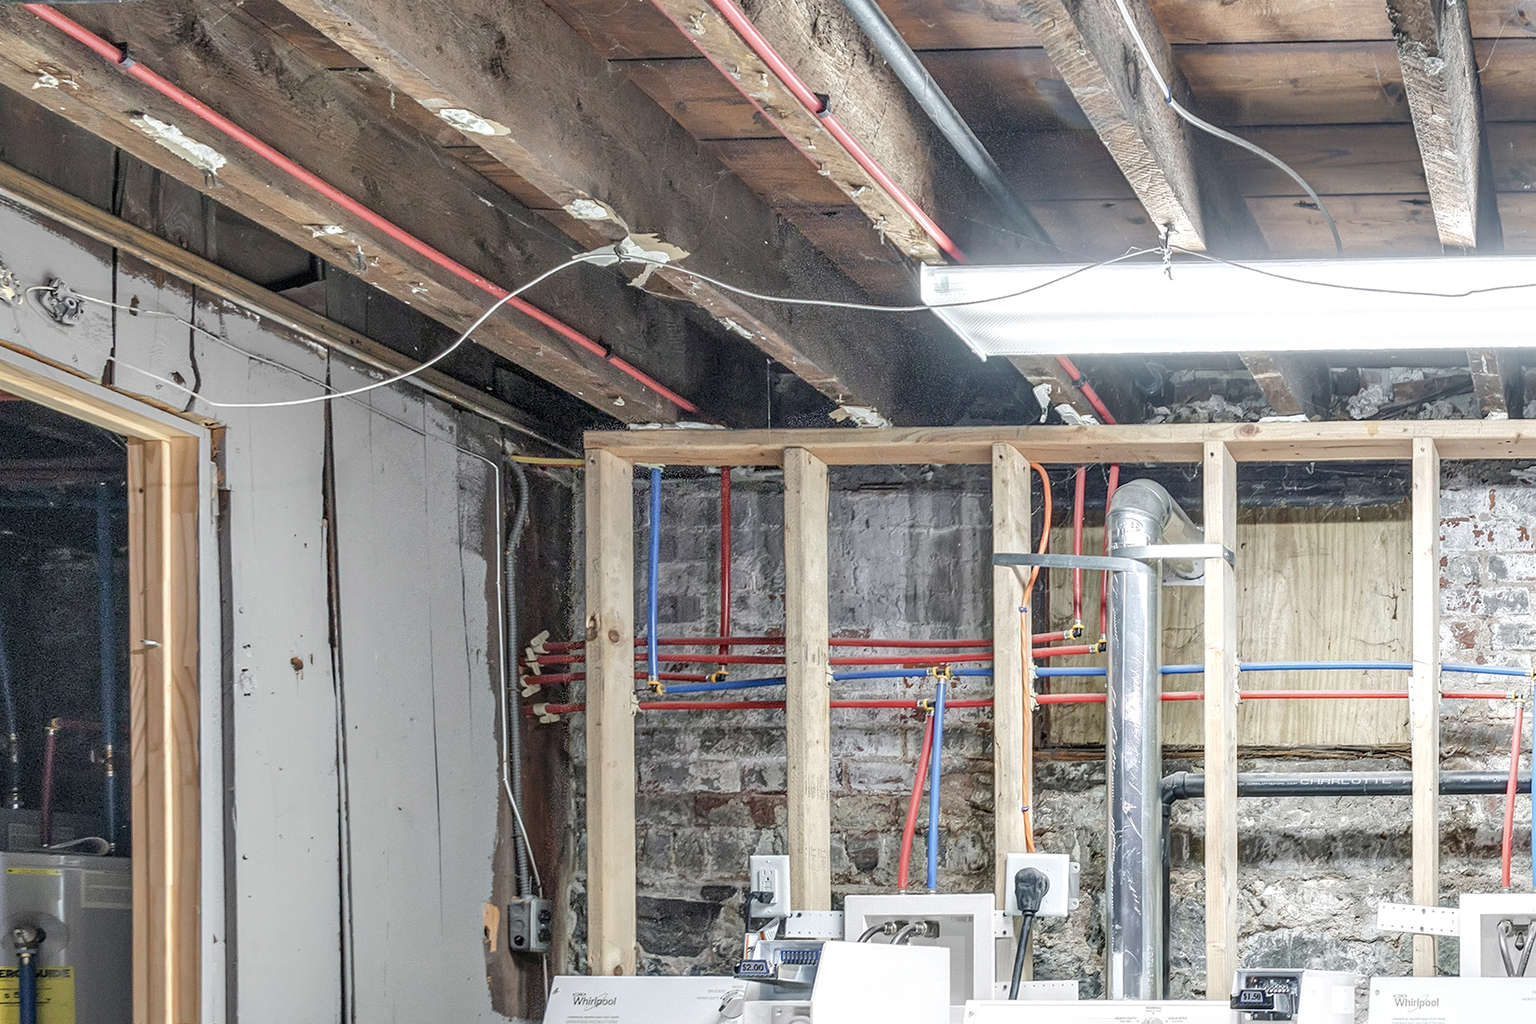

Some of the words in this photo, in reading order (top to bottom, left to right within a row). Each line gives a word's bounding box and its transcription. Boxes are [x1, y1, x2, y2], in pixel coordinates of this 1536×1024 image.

[1300, 777, 1391, 785] CHARLOTTE
[742, 963, 764, 972] $2.00
[1242, 992, 1262, 1001] $1.50
[572, 996, 617, 1008] Whirlpool
[1394, 997, 1440, 1010] Whirlpool
